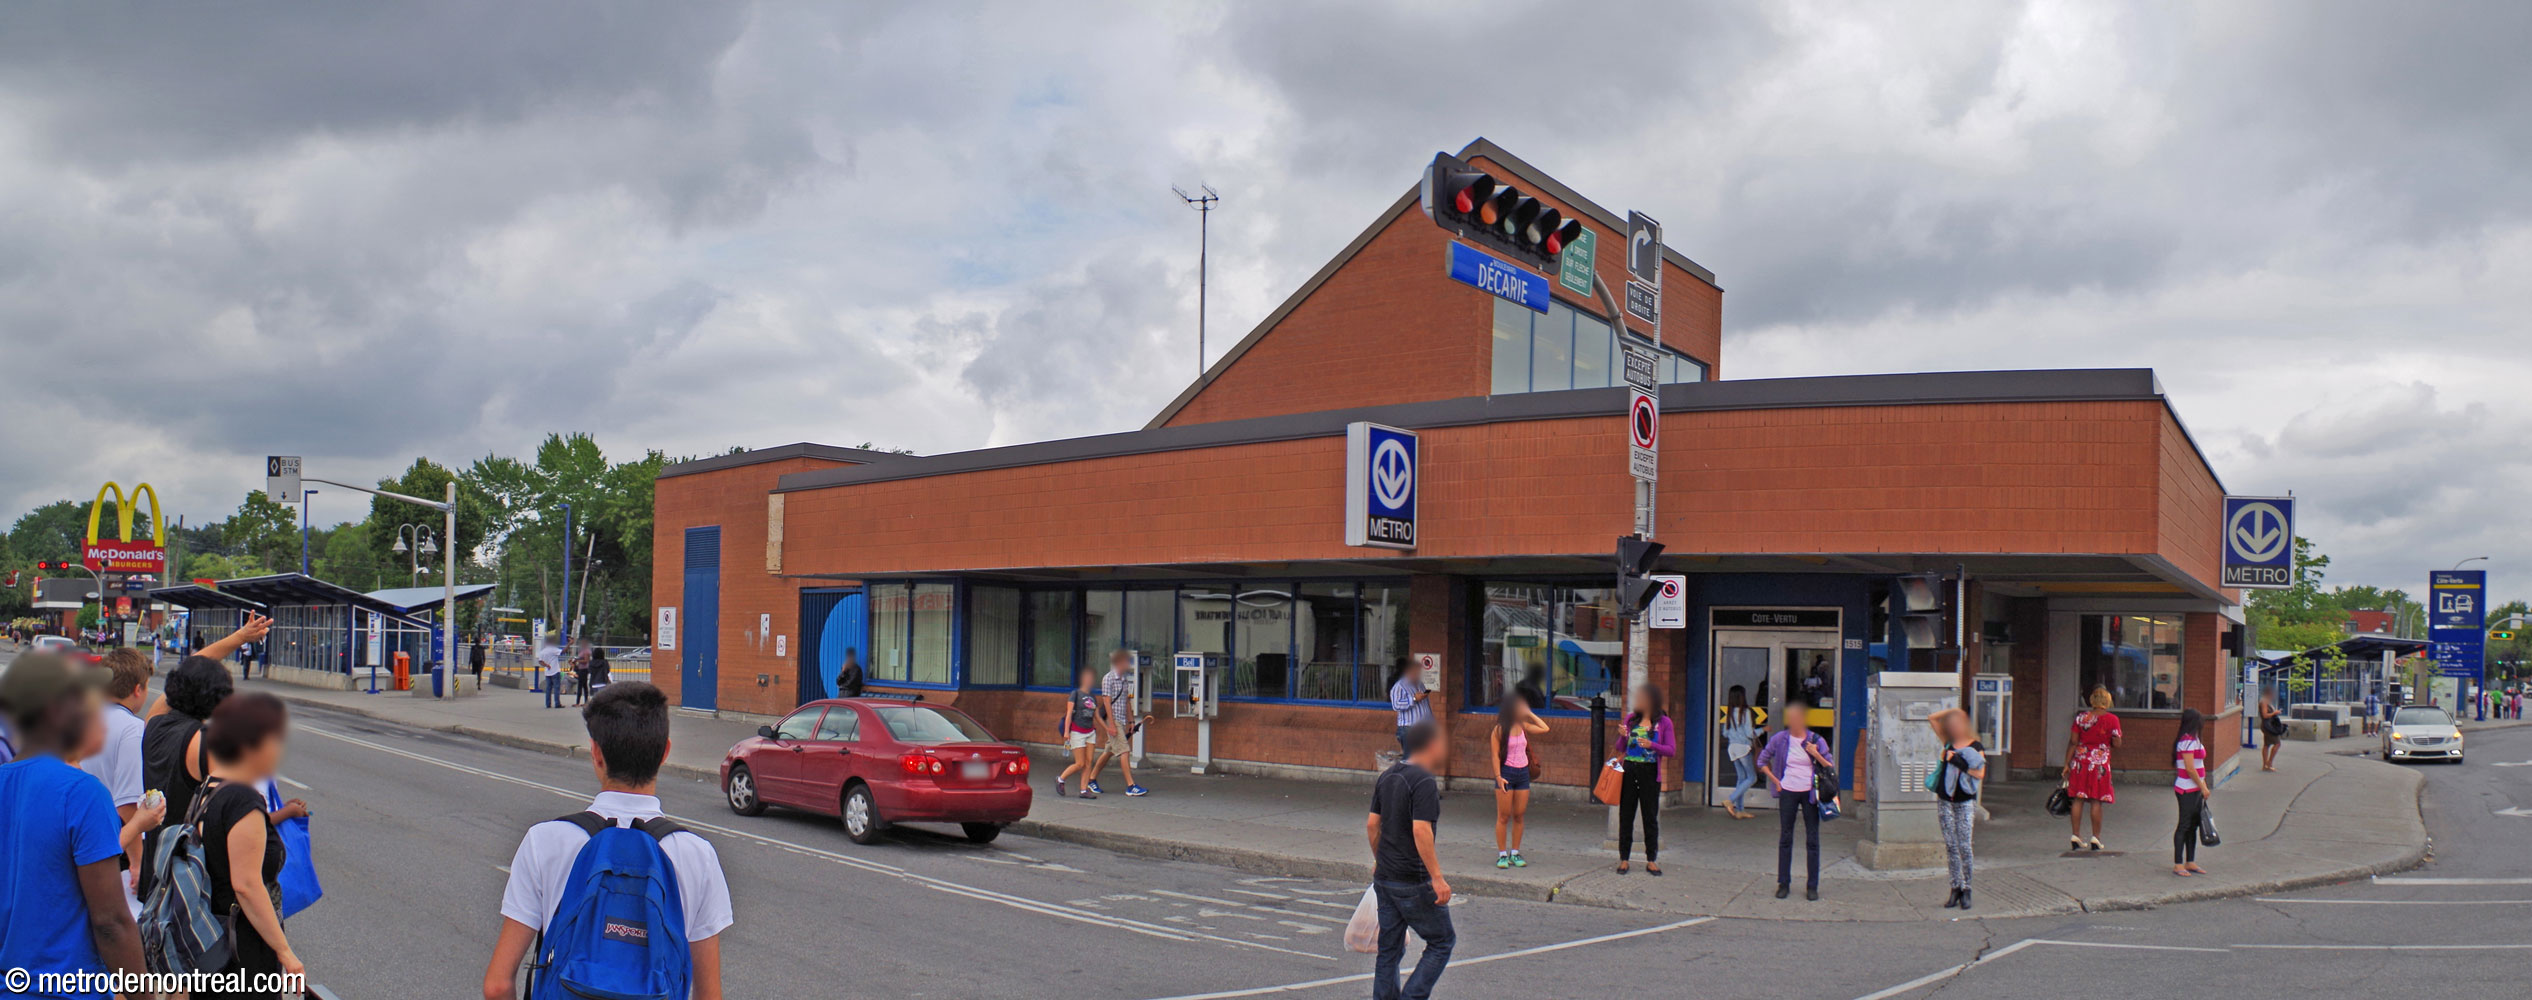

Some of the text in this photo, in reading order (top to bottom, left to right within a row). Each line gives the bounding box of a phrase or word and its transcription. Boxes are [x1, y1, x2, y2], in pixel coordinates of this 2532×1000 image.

[1478, 262, 1528, 304] DÉCARIE
[1630, 287, 1653, 306] VOIE DE
[1630, 300, 1650, 317] DROITE
[1627, 368, 1651, 386] AUTOBUS
[281, 459, 300, 467] BUS
[1634, 462, 1655, 476] AUTOBUS
[283, 467, 299, 475] STM
[87, 548, 165, 561] McDonald's
[1846, 640, 1862, 649] 1515
[1183, 657, 1195, 667] Bell
[605, 922, 648, 938] JANSPORT
